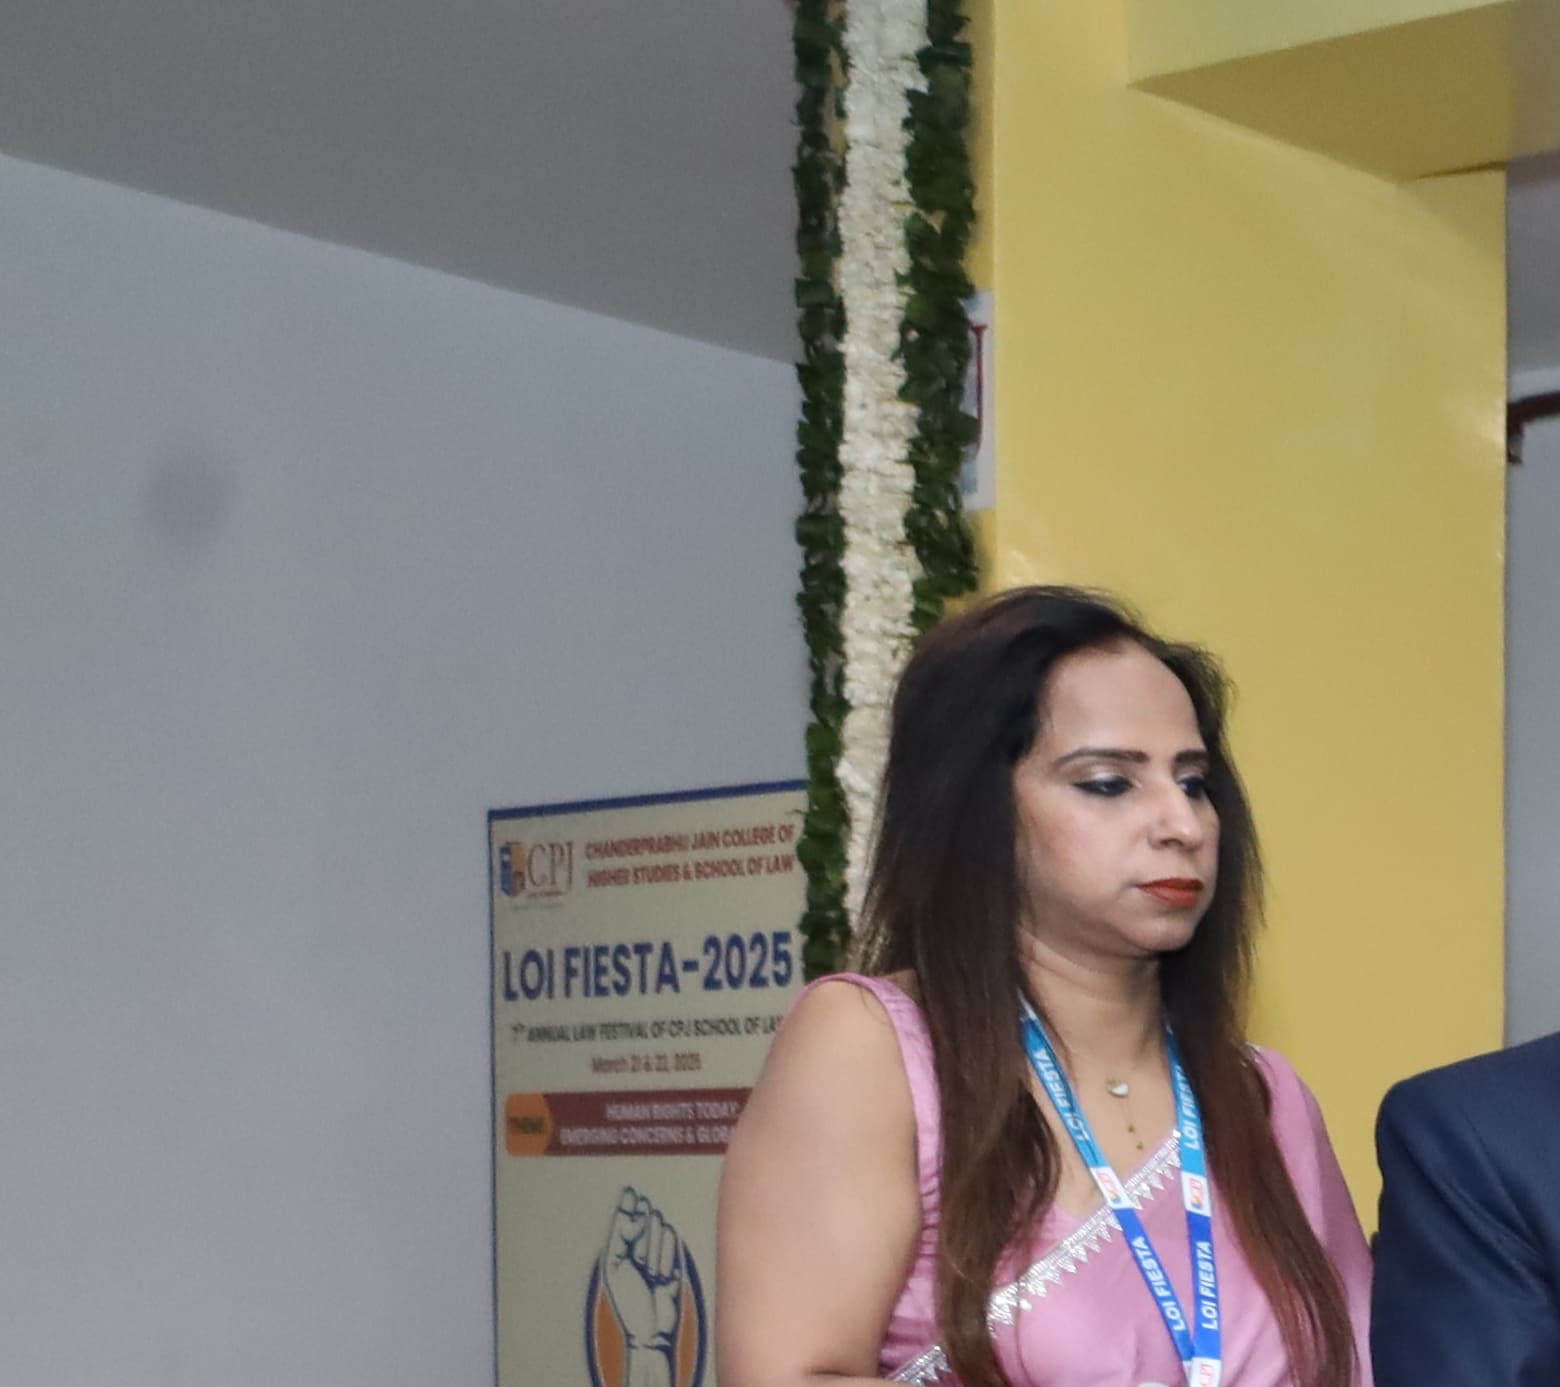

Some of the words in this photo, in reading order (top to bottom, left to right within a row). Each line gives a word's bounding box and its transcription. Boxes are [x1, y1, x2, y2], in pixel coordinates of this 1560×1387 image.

[722, 826, 775, 848] COLLEGE
[778, 824, 795, 843] OF
[527, 841, 573, 888] CPJ
[633, 863, 681, 885] STUDIES
[695, 857, 745, 880] SCHOOL
[748, 855, 764, 876] OF
[767, 854, 796, 873] LAW
[503, 947, 555, 1001] LOI
[565, 931, 792, 999] FIESTA-2025
[1032, 1048, 1070, 1108] FIESTA
[1184, 1117, 1200, 1150] LOI
[1131, 1237, 1171, 1303] FIESTA
[1200, 1241, 1217, 1299] FIESTA
[1163, 1299, 1186, 1332] LOI
[1202, 1297, 1219, 1330] LOI
